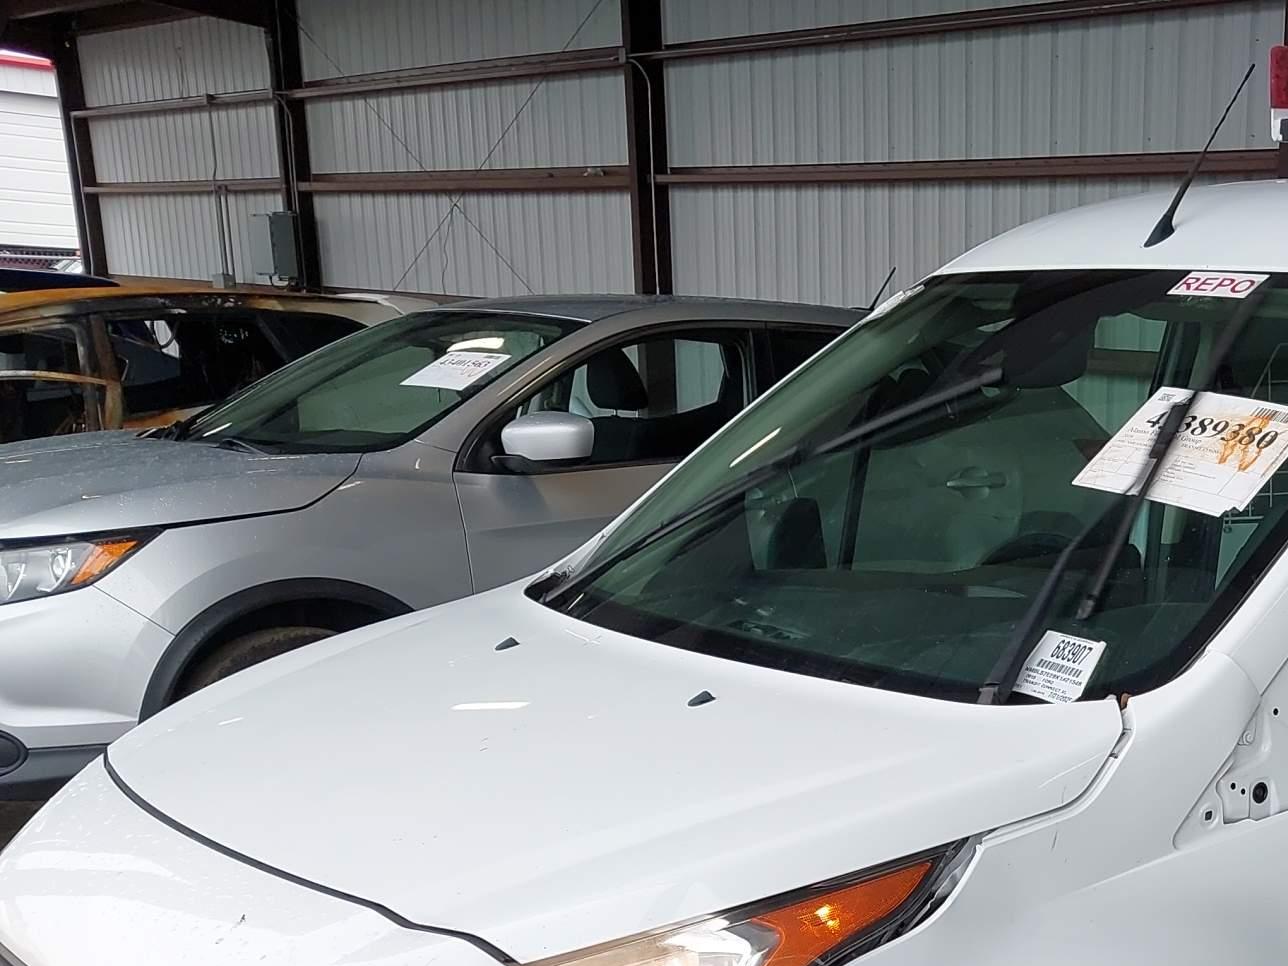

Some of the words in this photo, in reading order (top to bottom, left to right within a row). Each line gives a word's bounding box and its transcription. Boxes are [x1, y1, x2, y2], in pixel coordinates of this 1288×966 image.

[1175, 276, 1256, 294] REPO
[1146, 411, 1279, 450] 4389380
[1051, 639, 1093, 665] 683907
